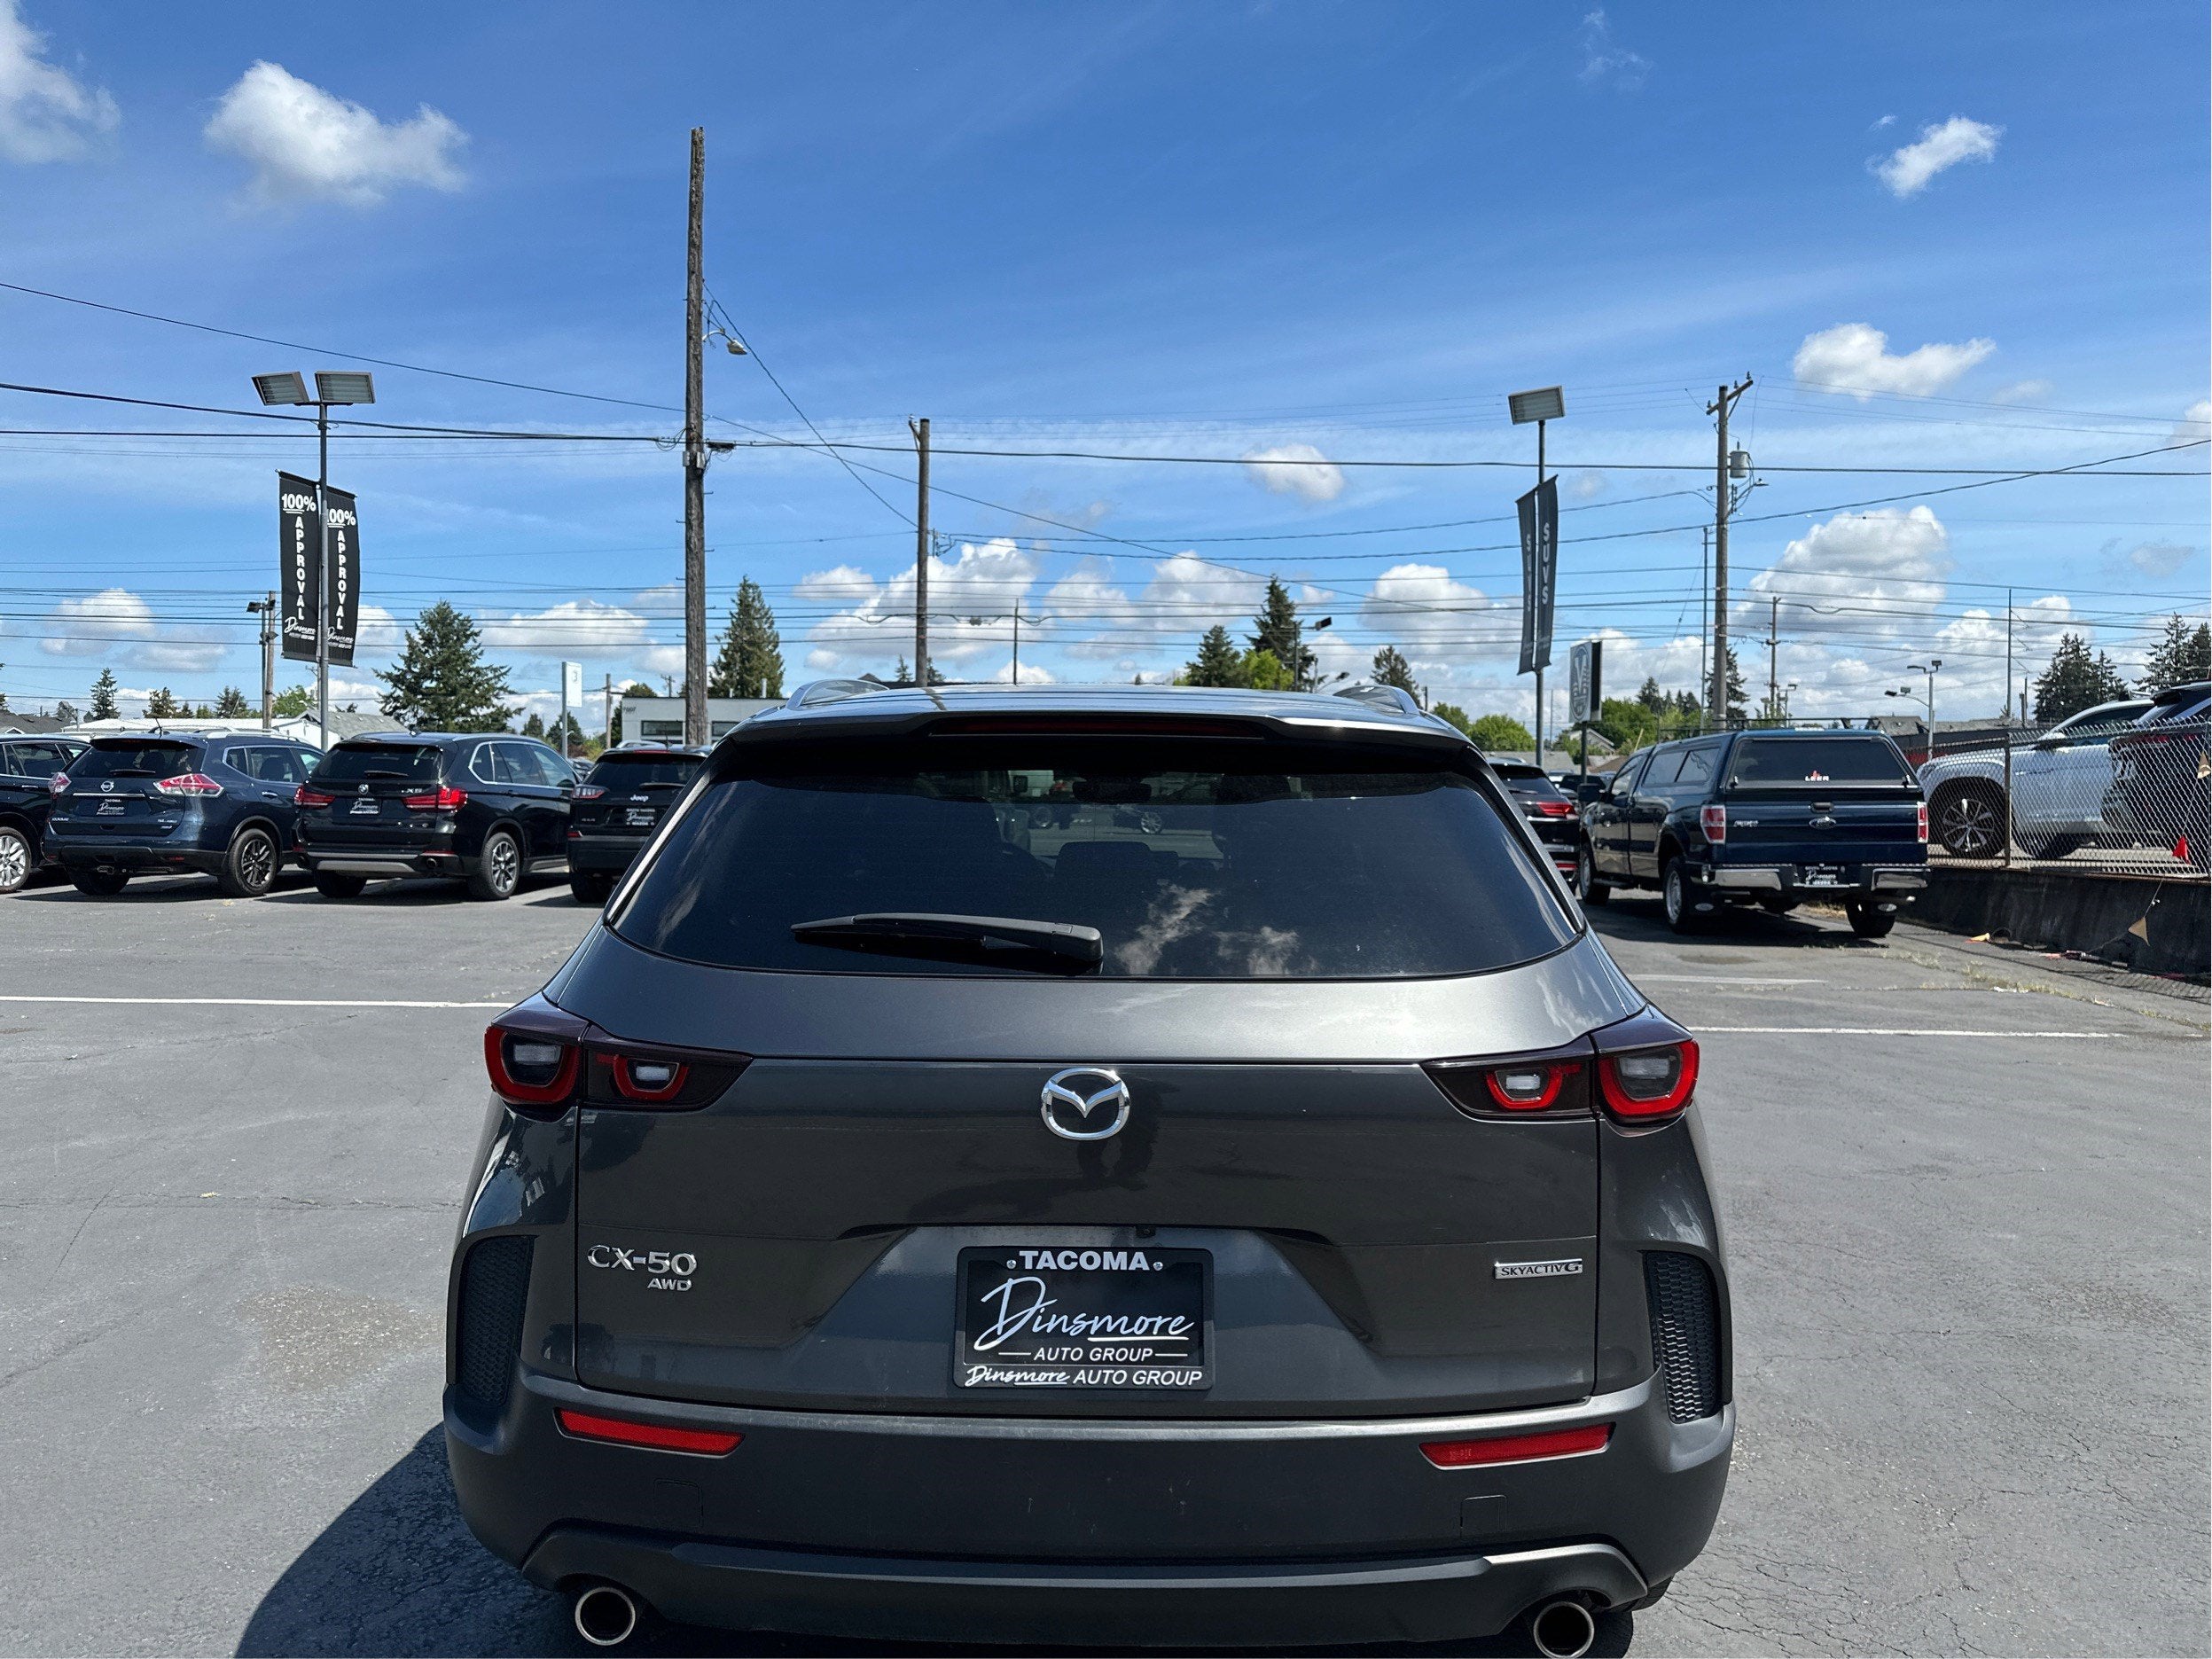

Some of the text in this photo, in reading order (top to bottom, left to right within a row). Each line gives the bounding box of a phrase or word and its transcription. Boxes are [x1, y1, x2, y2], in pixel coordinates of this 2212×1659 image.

[281, 493, 317, 512] 100%
[326, 508, 356, 526] 00%
[295, 516, 305, 621] APPROVAL
[1542, 522, 1551, 605] SUVS
[336, 529, 347, 630] APPROVAL
[587, 1244, 697, 1276] CX-50
[1020, 1250, 1150, 1271] TACOMA
[646, 1278, 692, 1292] AWD
[973, 1276, 1195, 1351] Dinsmore
[1034, 1347, 1153, 1362] AUTO GROUP
[965, 1366, 1203, 1388] Dinsmore AUTO GROUP
